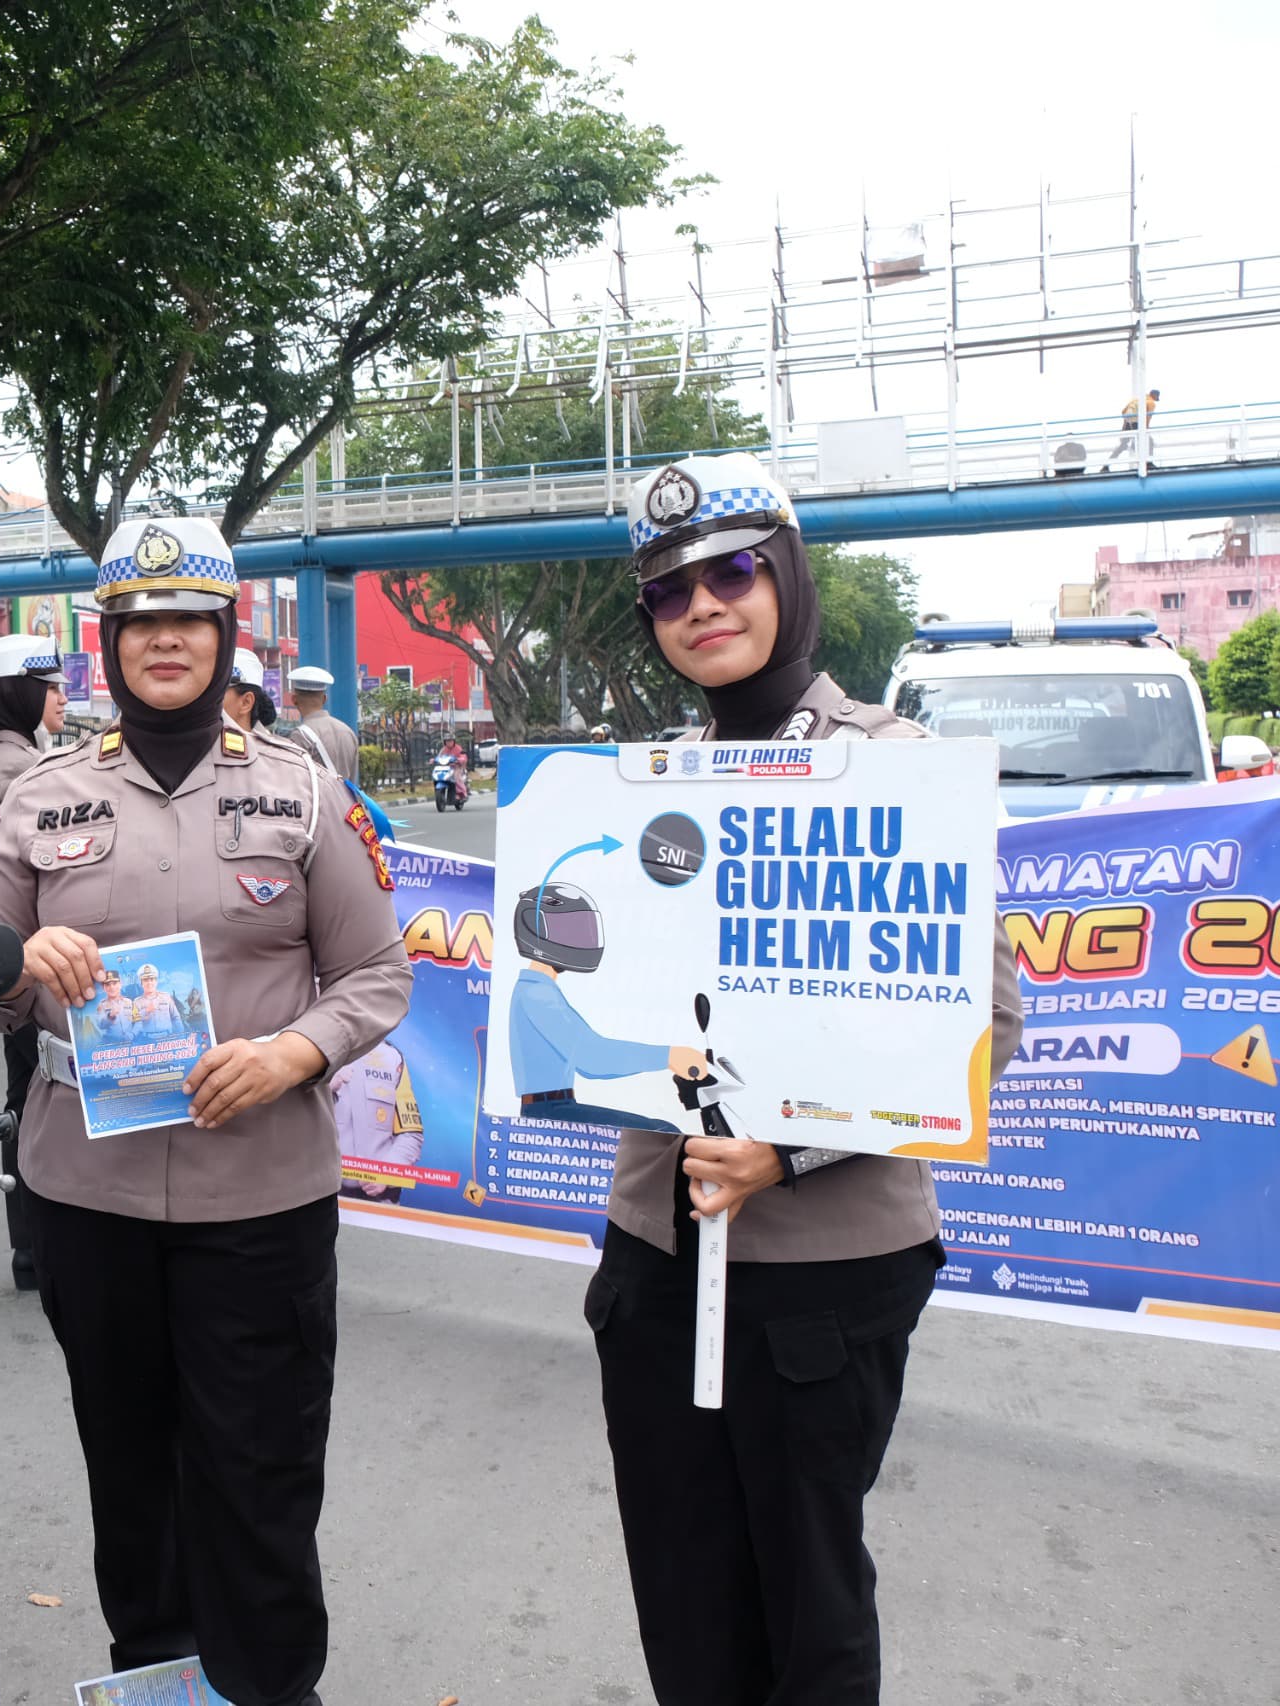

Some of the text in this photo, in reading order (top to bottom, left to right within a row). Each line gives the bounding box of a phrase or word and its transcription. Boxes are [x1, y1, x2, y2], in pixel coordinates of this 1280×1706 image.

[1133, 682, 1172, 698] 701
[712, 748, 812, 764] DITLANTAS
[753, 766, 807, 774] POLDA RIAU
[37, 800, 114, 831] RIZA
[220, 797, 302, 818] POLRI
[720, 806, 902, 858] SELALU
[657, 846, 686, 866] SNI
[397, 876, 432, 888] RIAU
[716, 860, 967, 915] GUNAKAN
[719, 917, 961, 976] HELM SNI
[1183, 898, 1280, 976] 2
[717, 975, 972, 1004] SAAT BERKENDARA
[1182, 988, 1280, 1013] 2026
[365, 1069, 392, 1081] POLRI
[1030, 1098, 1107, 1114] RANGKA,
[1109, 1100, 1194, 1119] MERUBAH
[1197, 1106, 1276, 1126] SPEKTEK
[510, 1118, 587, 1134] KENDARAAN
[922, 1115, 961, 1131] STRONG
[989, 1117, 1200, 1140] BUKAN PERUNTUKANNYA
[490, 1131, 502, 1142] 6.
[509, 1132, 589, 1150] KENDARAAN
[489, 1148, 498, 1159] 7.
[508, 1150, 589, 1168] KENDARAAN
[488, 1165, 608, 1188] 8. KENDARAAN R2
[1007, 1174, 1065, 1191] ORANG
[488, 1182, 499, 1193] 9.
[506, 1185, 587, 1203] KENDARAAN
[1035, 1217, 1081, 1234] LEBIH
[1085, 1222, 1125, 1238] DARI
[958, 1230, 1010, 1247] JALAN
[949, 1274, 970, 1283] Bumi
[1018, 1272, 1062, 1285] Melindungi
[1018, 1281, 1089, 1297] Menjaga Marwah
